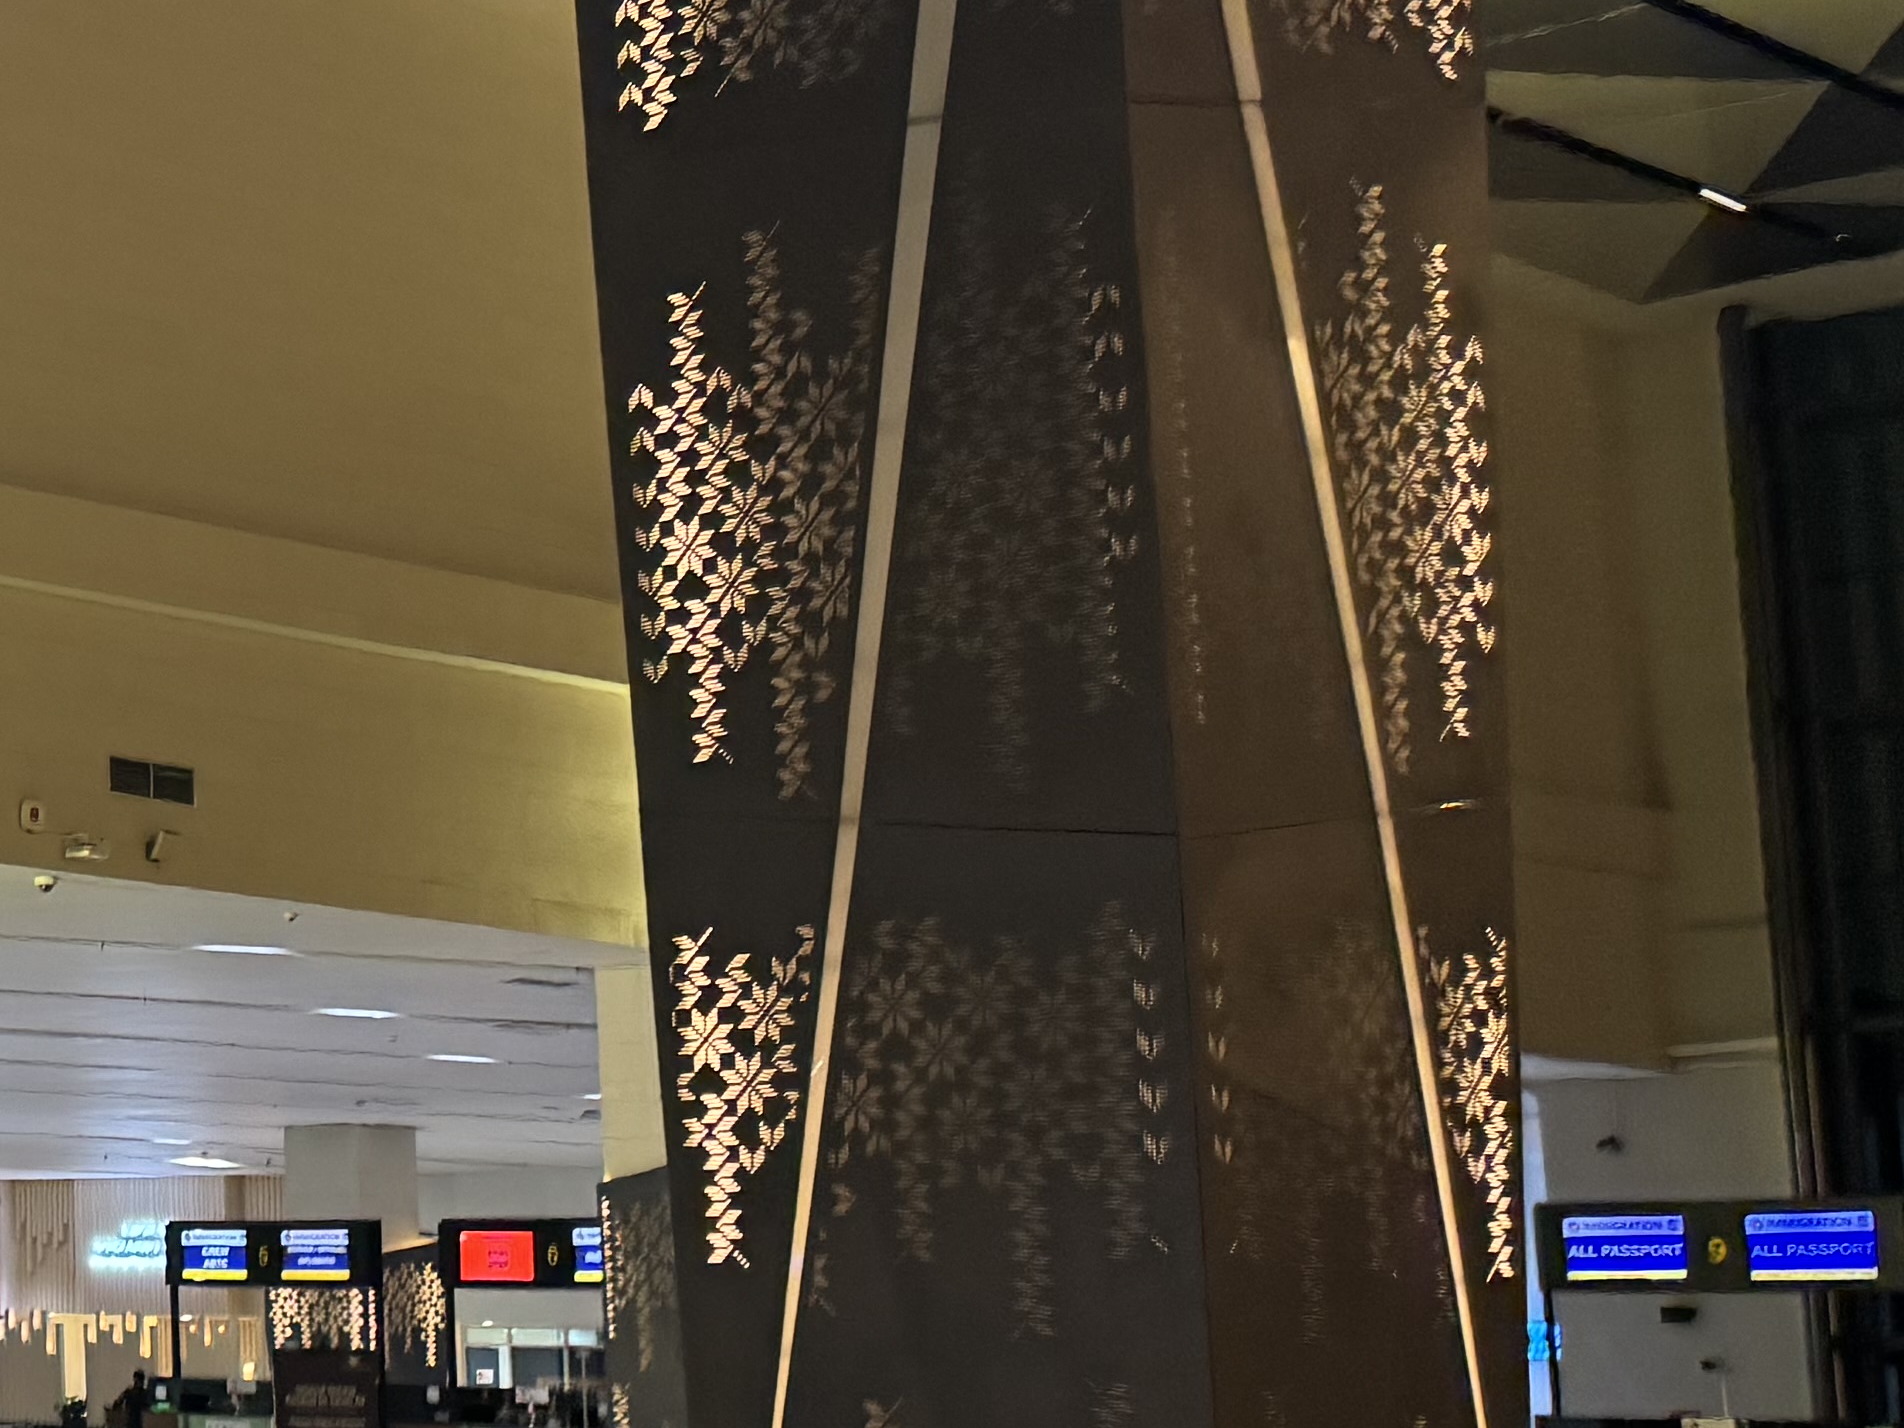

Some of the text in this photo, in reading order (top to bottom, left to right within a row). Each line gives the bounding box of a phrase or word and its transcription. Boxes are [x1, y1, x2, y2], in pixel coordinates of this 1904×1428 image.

[1567, 1242, 1684, 1258] ALL PASSPORT
[1751, 1241, 1875, 1259] ALL PASSPORT
